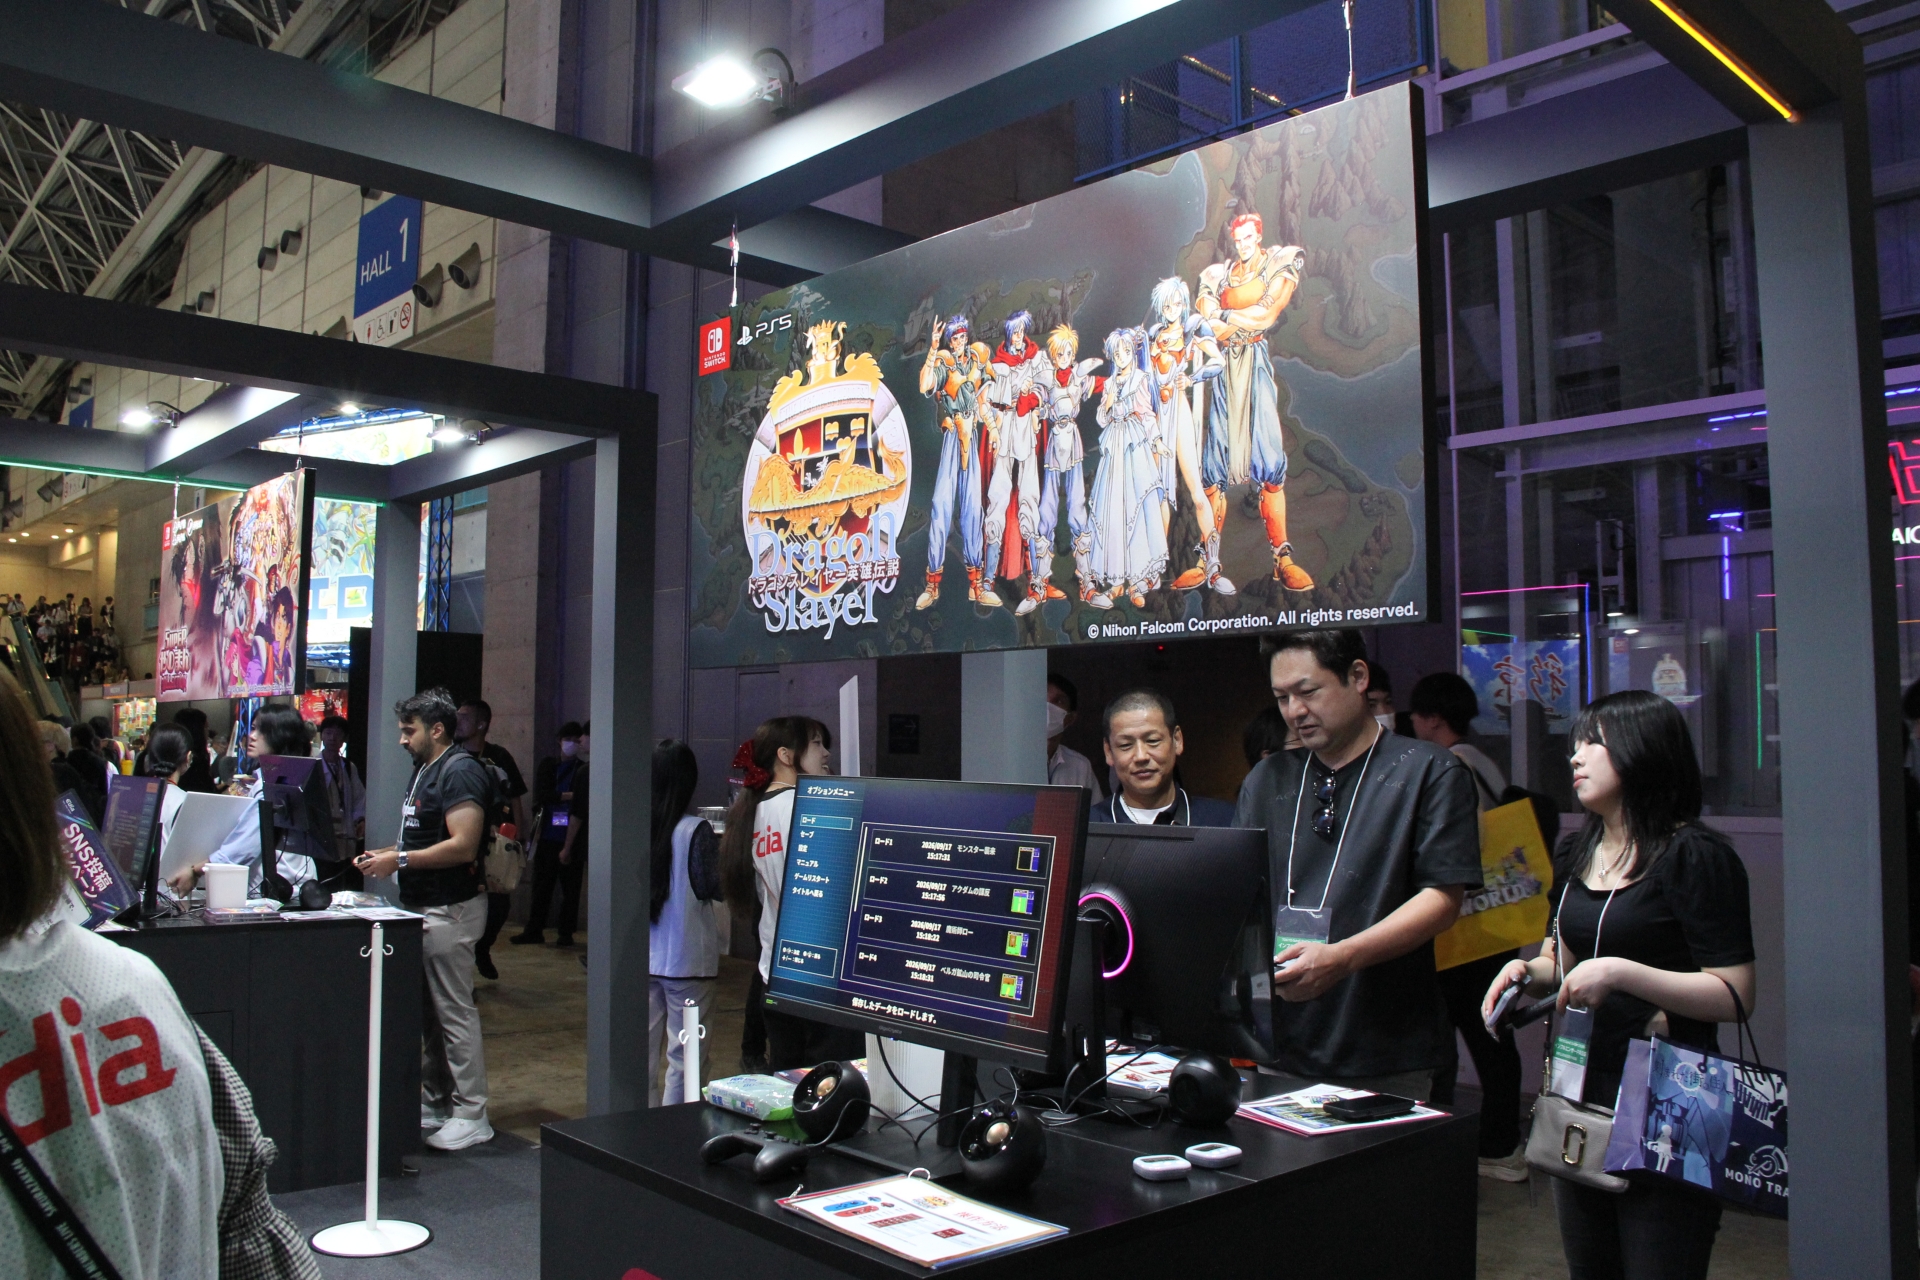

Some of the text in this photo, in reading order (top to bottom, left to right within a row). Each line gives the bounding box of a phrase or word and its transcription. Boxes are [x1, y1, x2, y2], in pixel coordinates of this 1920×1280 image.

[360, 217, 409, 286] HALL 1
[755, 314, 792, 338] PS5
[703, 351, 726, 361] NINTENDO
[703, 357, 727, 369] SWITCH
[749, 510, 901, 579] Dragon
[748, 557, 901, 595] ドラゴンスレイヤー英雄伝説
[764, 580, 879, 641] Slayer
[1102, 621, 1137, 638] Nihon
[1140, 617, 1185, 635] Falcom
[1188, 613, 1273, 633] Corporation.
[1277, 610, 1297, 625] All
[1300, 607, 1343, 627] rights
[1346, 601, 1419, 620] reserved.
[807, 785, 855, 797] オプションメニュー
[801, 816, 816, 825] ロード
[800, 830, 815, 839] セーブ
[874, 837, 893, 846] ロード1
[64, 823, 114, 892] SNS投稿
[796, 858, 819, 868] マニュアル
[926, 852, 951, 862] 15:17:31
[794, 872, 830, 884] ゲームリスタート
[869, 875, 889, 885] ロード2
[792, 887, 824, 898] タイトルへ戻る
[863, 913, 883, 923] ロード3
[858, 951, 878, 962] ロード4
[851, 996, 937, 1024] 保存したデータをロードします。
[0, 996, 178, 1147] dia
[1724, 1167, 1762, 1189] MONO
